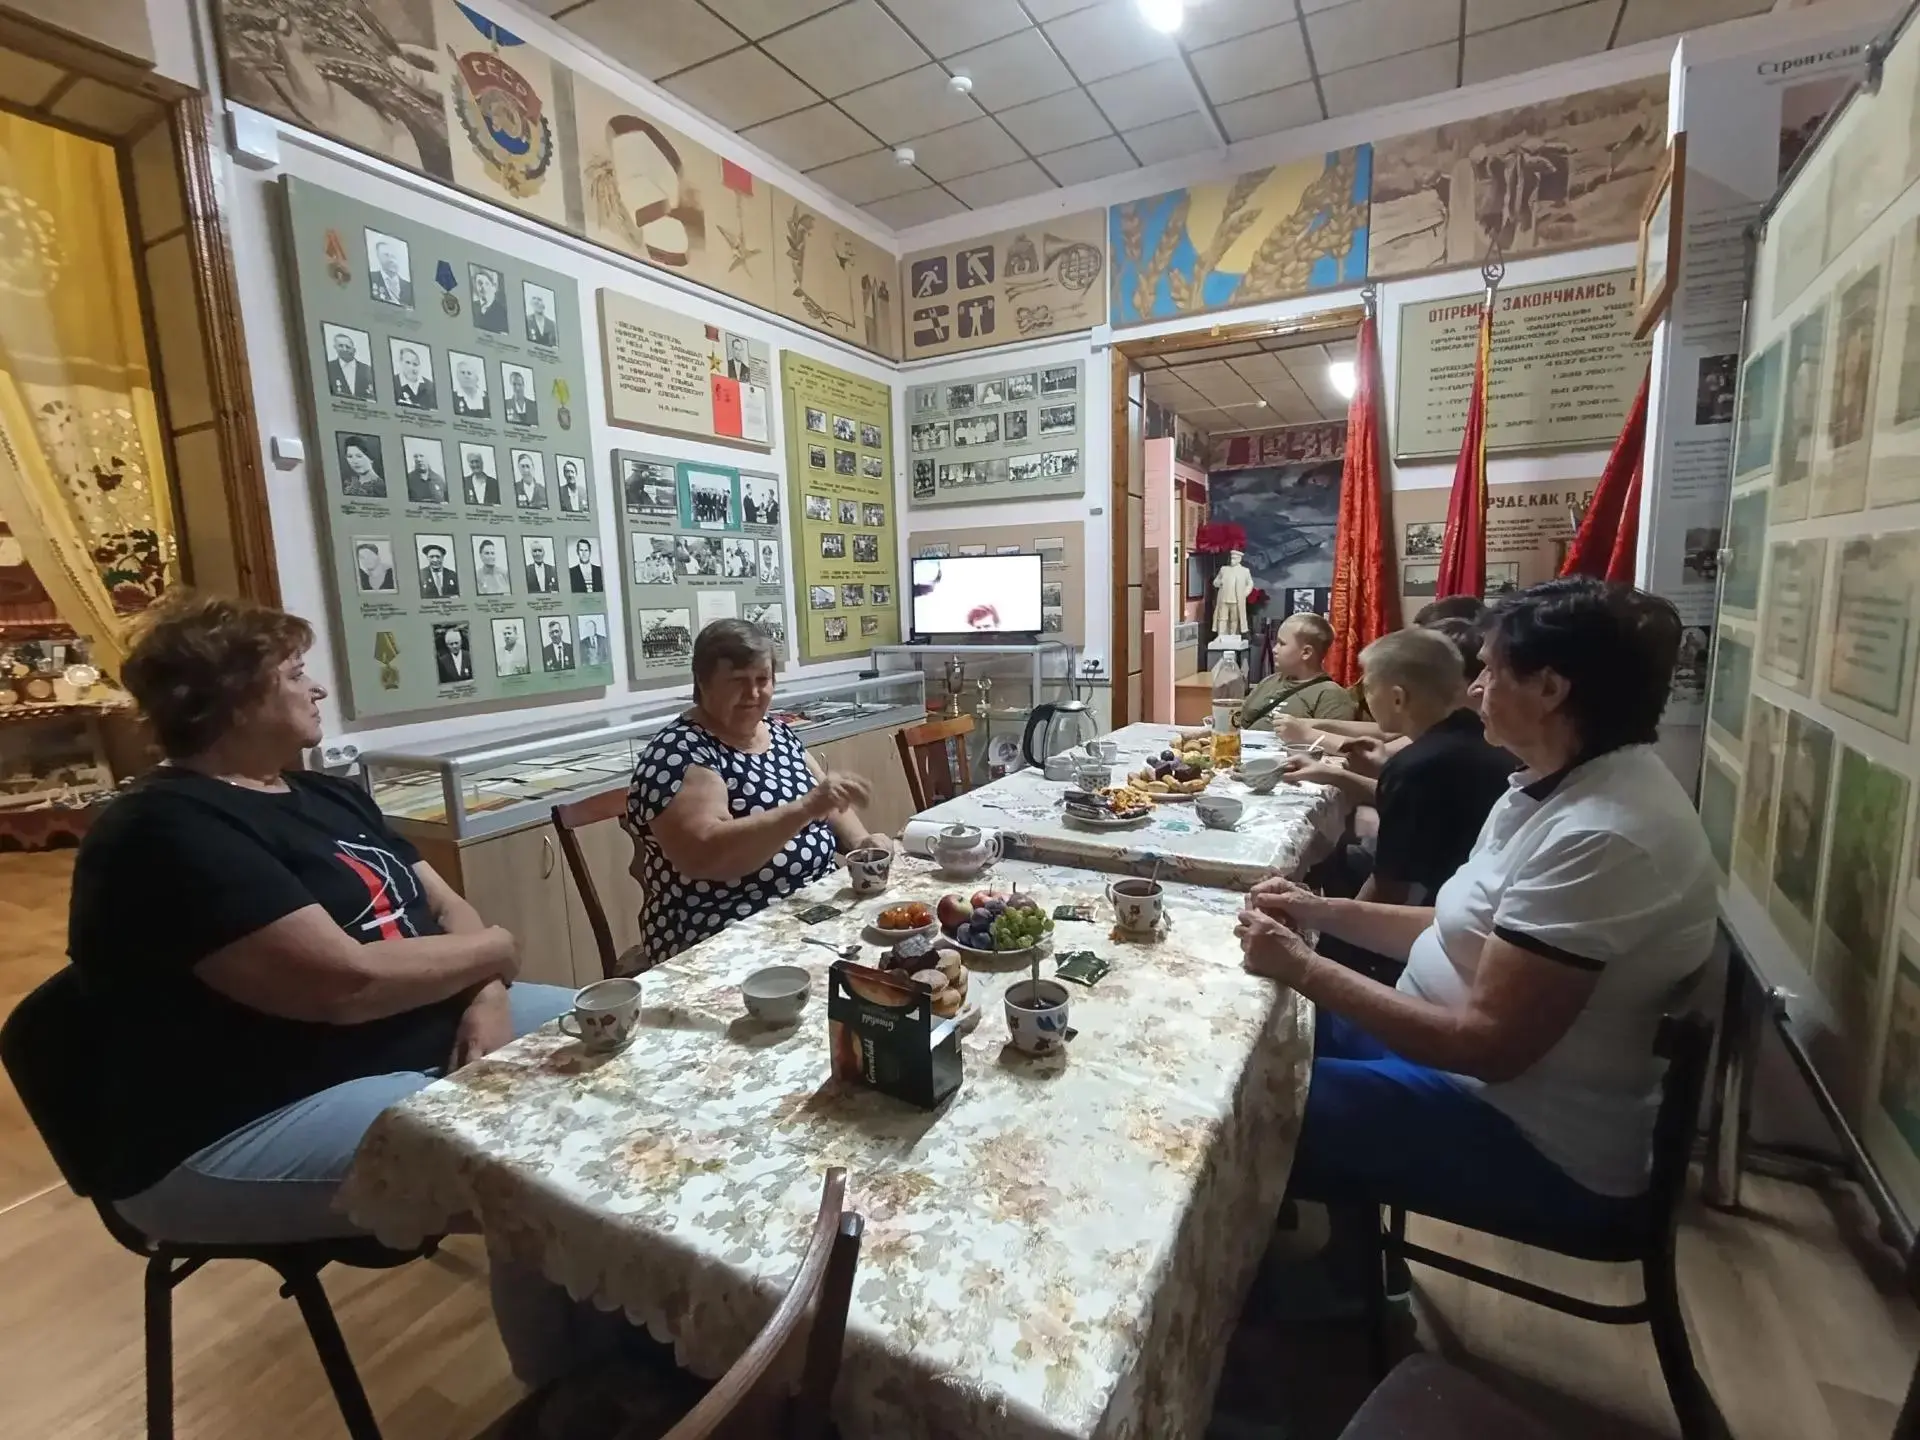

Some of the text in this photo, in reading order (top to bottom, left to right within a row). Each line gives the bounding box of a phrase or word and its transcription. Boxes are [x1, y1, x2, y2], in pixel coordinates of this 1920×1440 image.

[1503, 282, 1616, 311] ЗАКОНЧИЛИСЬ
[1486, 493, 1528, 509] РУДЕ,
[1529, 492, 1560, 506] КАК
